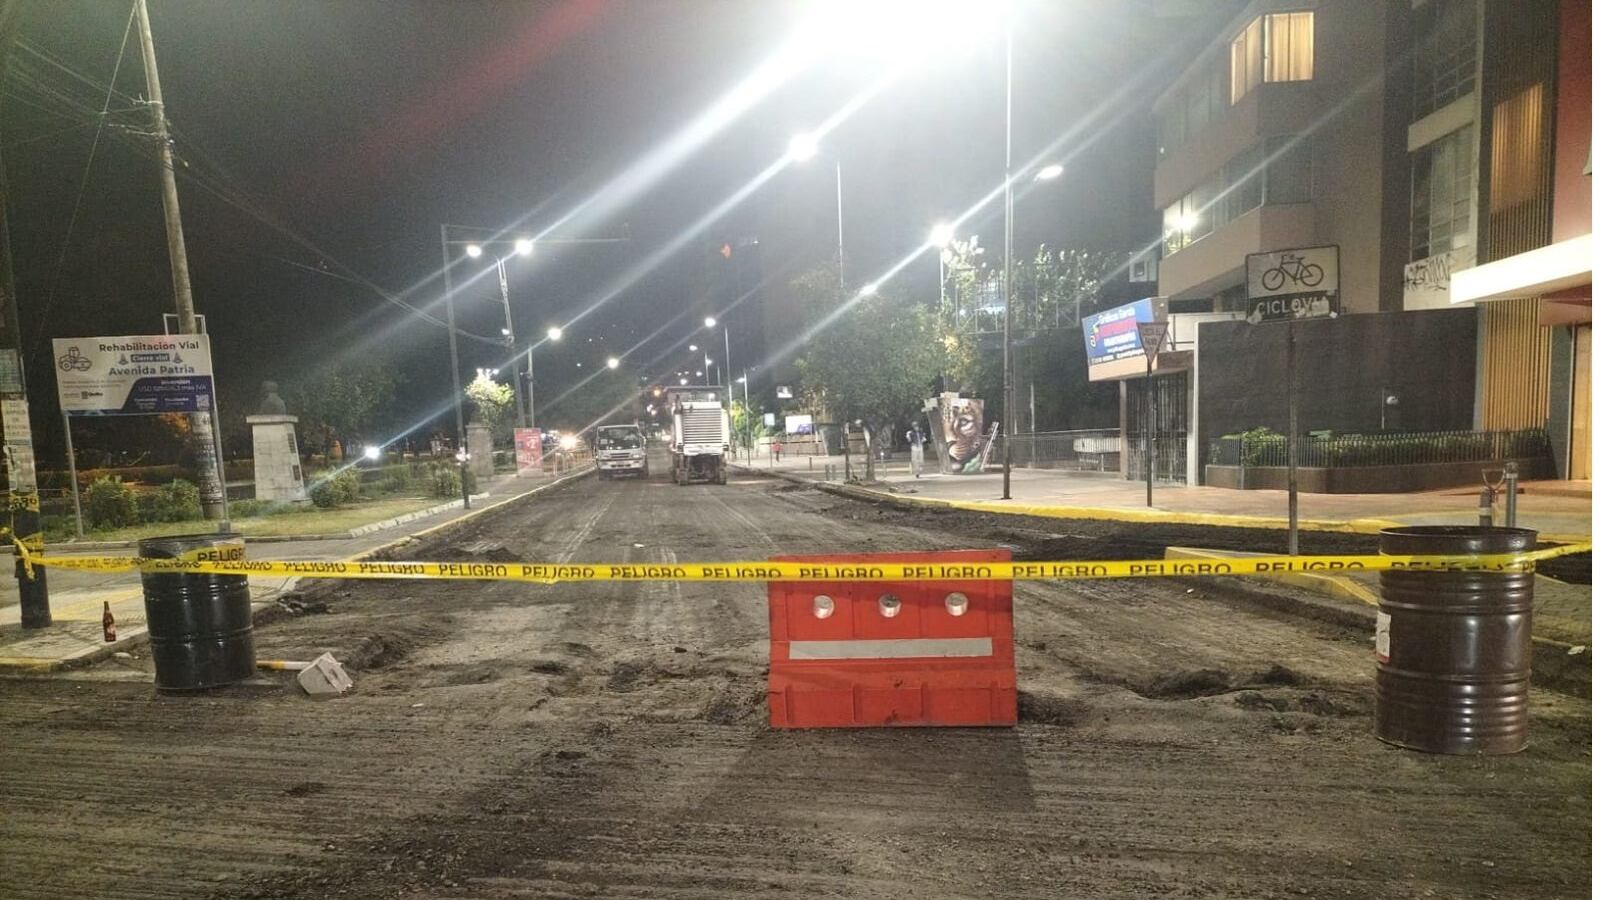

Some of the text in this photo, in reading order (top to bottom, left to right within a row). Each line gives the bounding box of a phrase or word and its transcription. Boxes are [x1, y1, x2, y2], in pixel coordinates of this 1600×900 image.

[1257, 296, 1329, 315] CICLOV
[99, 340, 199, 352] Rehabilitación Vial
[108, 364, 195, 376] Avenida Patria
[359, 562, 425, 575] PELIGRO
[439, 564, 508, 578] PELIGRO
[522, 566, 596, 579] PELIGRO
[610, 567, 687, 578] PELIGRO
[1012, 565, 1107, 578] PELIGRO
[1130, 563, 1232, 576] PELIGRO
